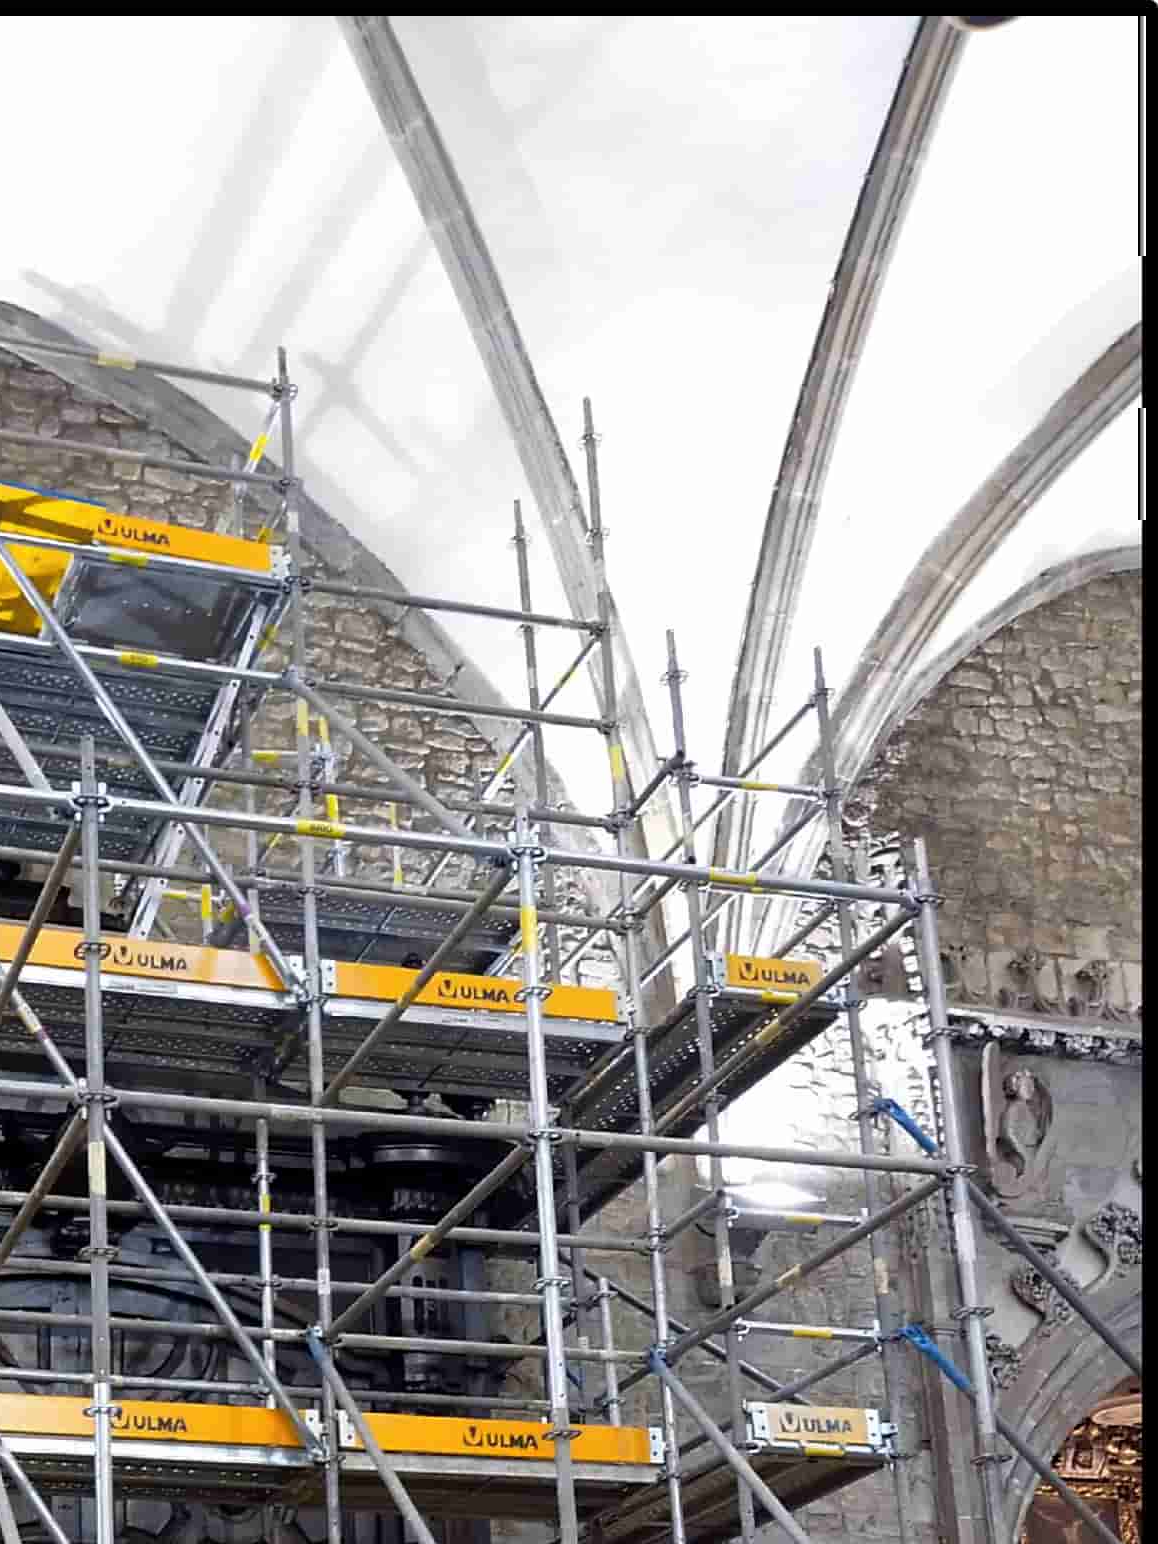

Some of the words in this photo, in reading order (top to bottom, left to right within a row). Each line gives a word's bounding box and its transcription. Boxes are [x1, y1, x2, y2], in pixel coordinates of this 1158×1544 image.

[121, 527, 170, 544] ULMA
[137, 954, 187, 971] ULMA
[761, 969, 810, 985] ULMA
[460, 986, 510, 1003] ULMA
[133, 1416, 187, 1433] ULMA
[802, 1418, 853, 1433] ULMA
[485, 1432, 538, 1449] ULMA
